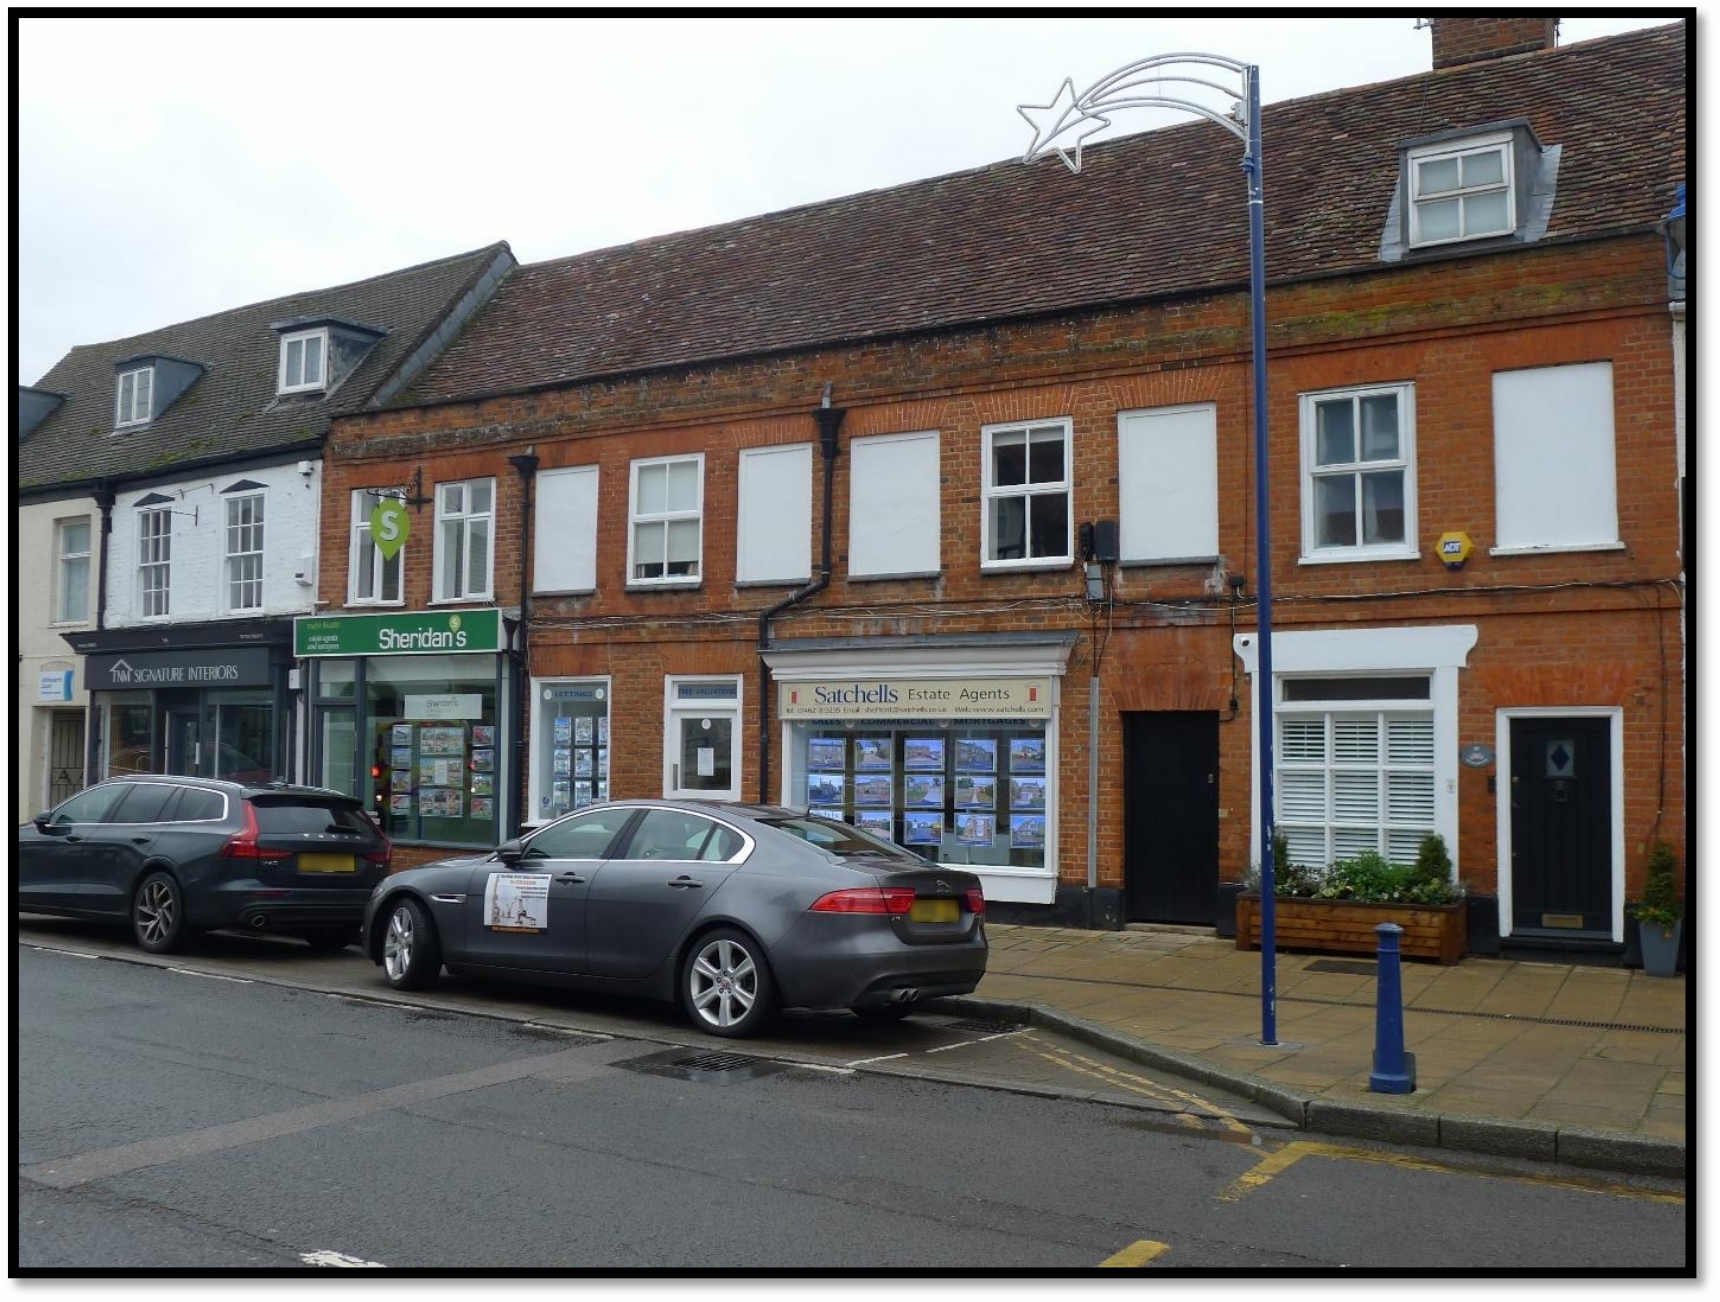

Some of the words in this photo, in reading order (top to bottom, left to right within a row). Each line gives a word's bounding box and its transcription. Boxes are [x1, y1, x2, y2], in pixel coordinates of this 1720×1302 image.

[380, 510, 399, 541] S
[1443, 542, 1461, 553] ADT
[134, 667, 186, 683] SIGNATURE
[188, 665, 239, 681] INTERIORS
[554, 690, 593, 698] LETTINGS
[815, 684, 898, 703] Satchells
[908, 688, 951, 701] Estate
[959, 687, 1010, 703] Agents
